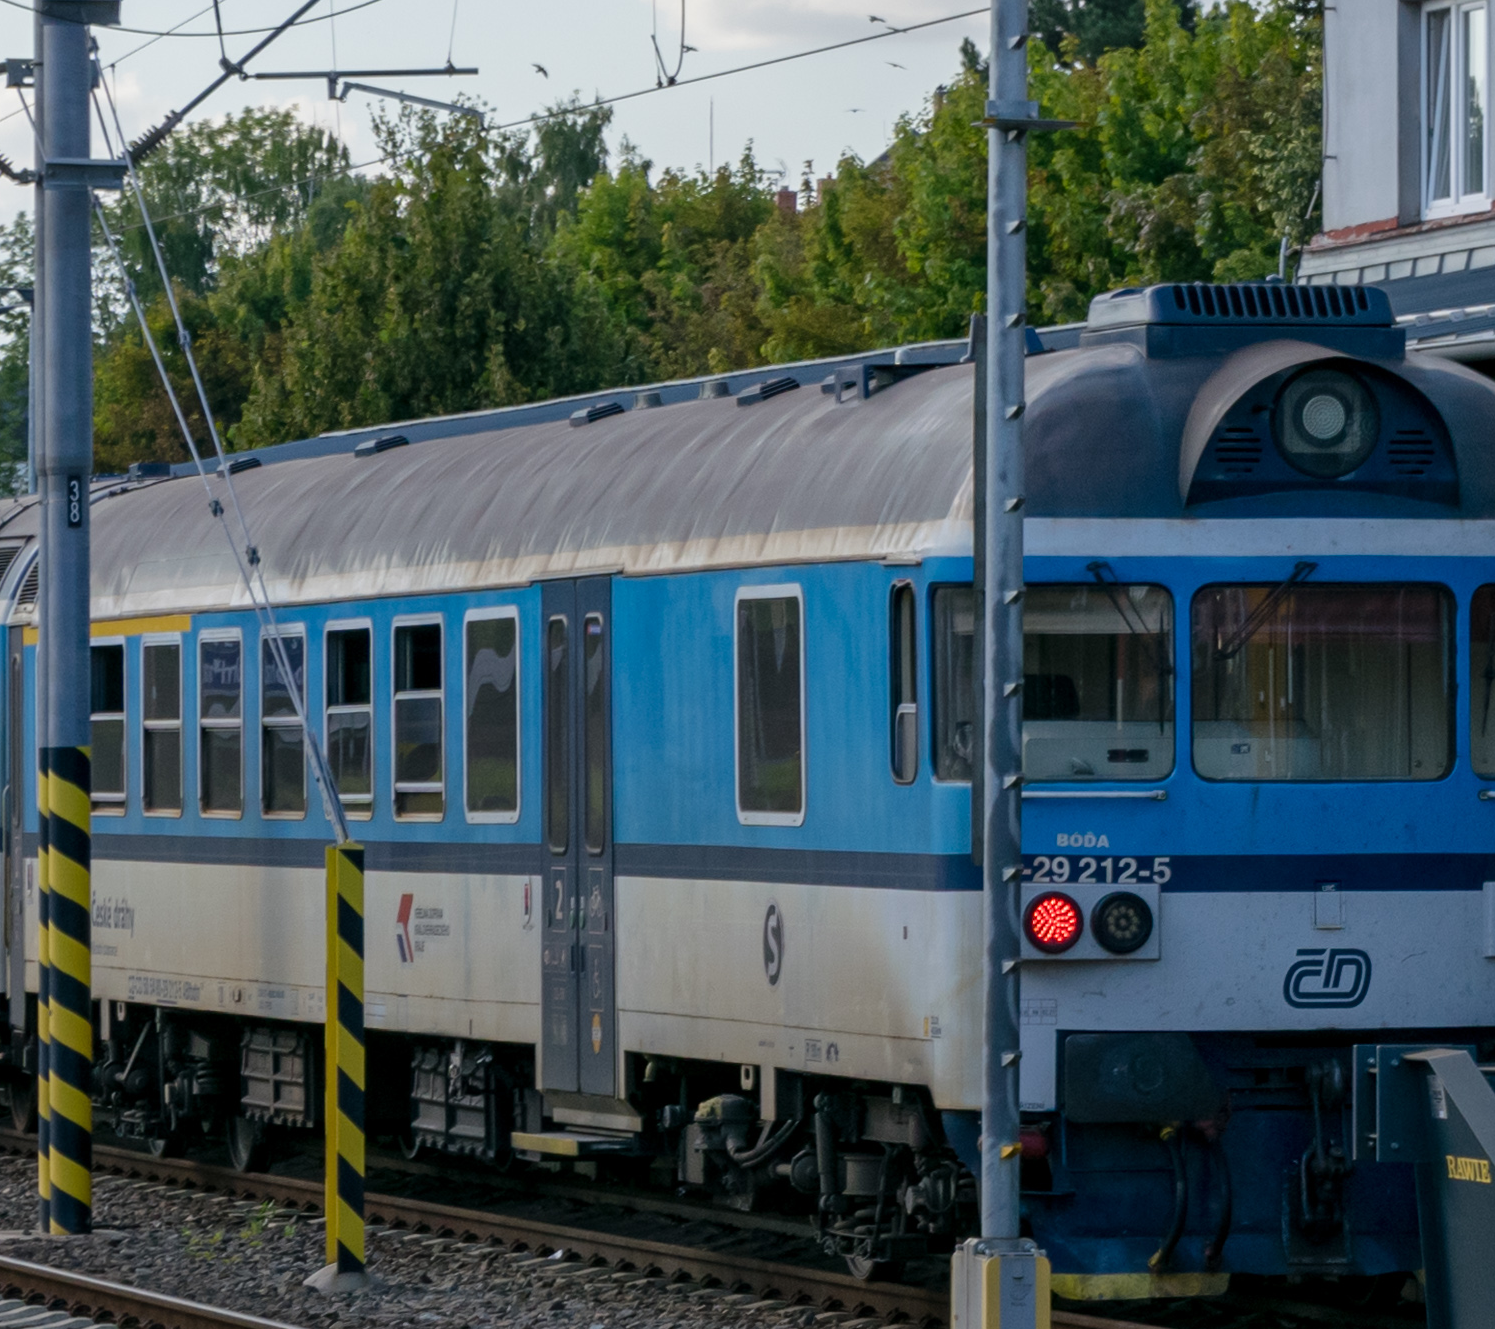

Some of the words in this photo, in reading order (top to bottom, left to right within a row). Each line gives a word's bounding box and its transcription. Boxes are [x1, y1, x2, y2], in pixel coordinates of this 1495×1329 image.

[1021, 855, 1071, 883] -29
[1077, 856, 1172, 884] 212-5
[554, 879, 564, 920] 2
[1445, 1154, 1493, 1184] RAWIE
